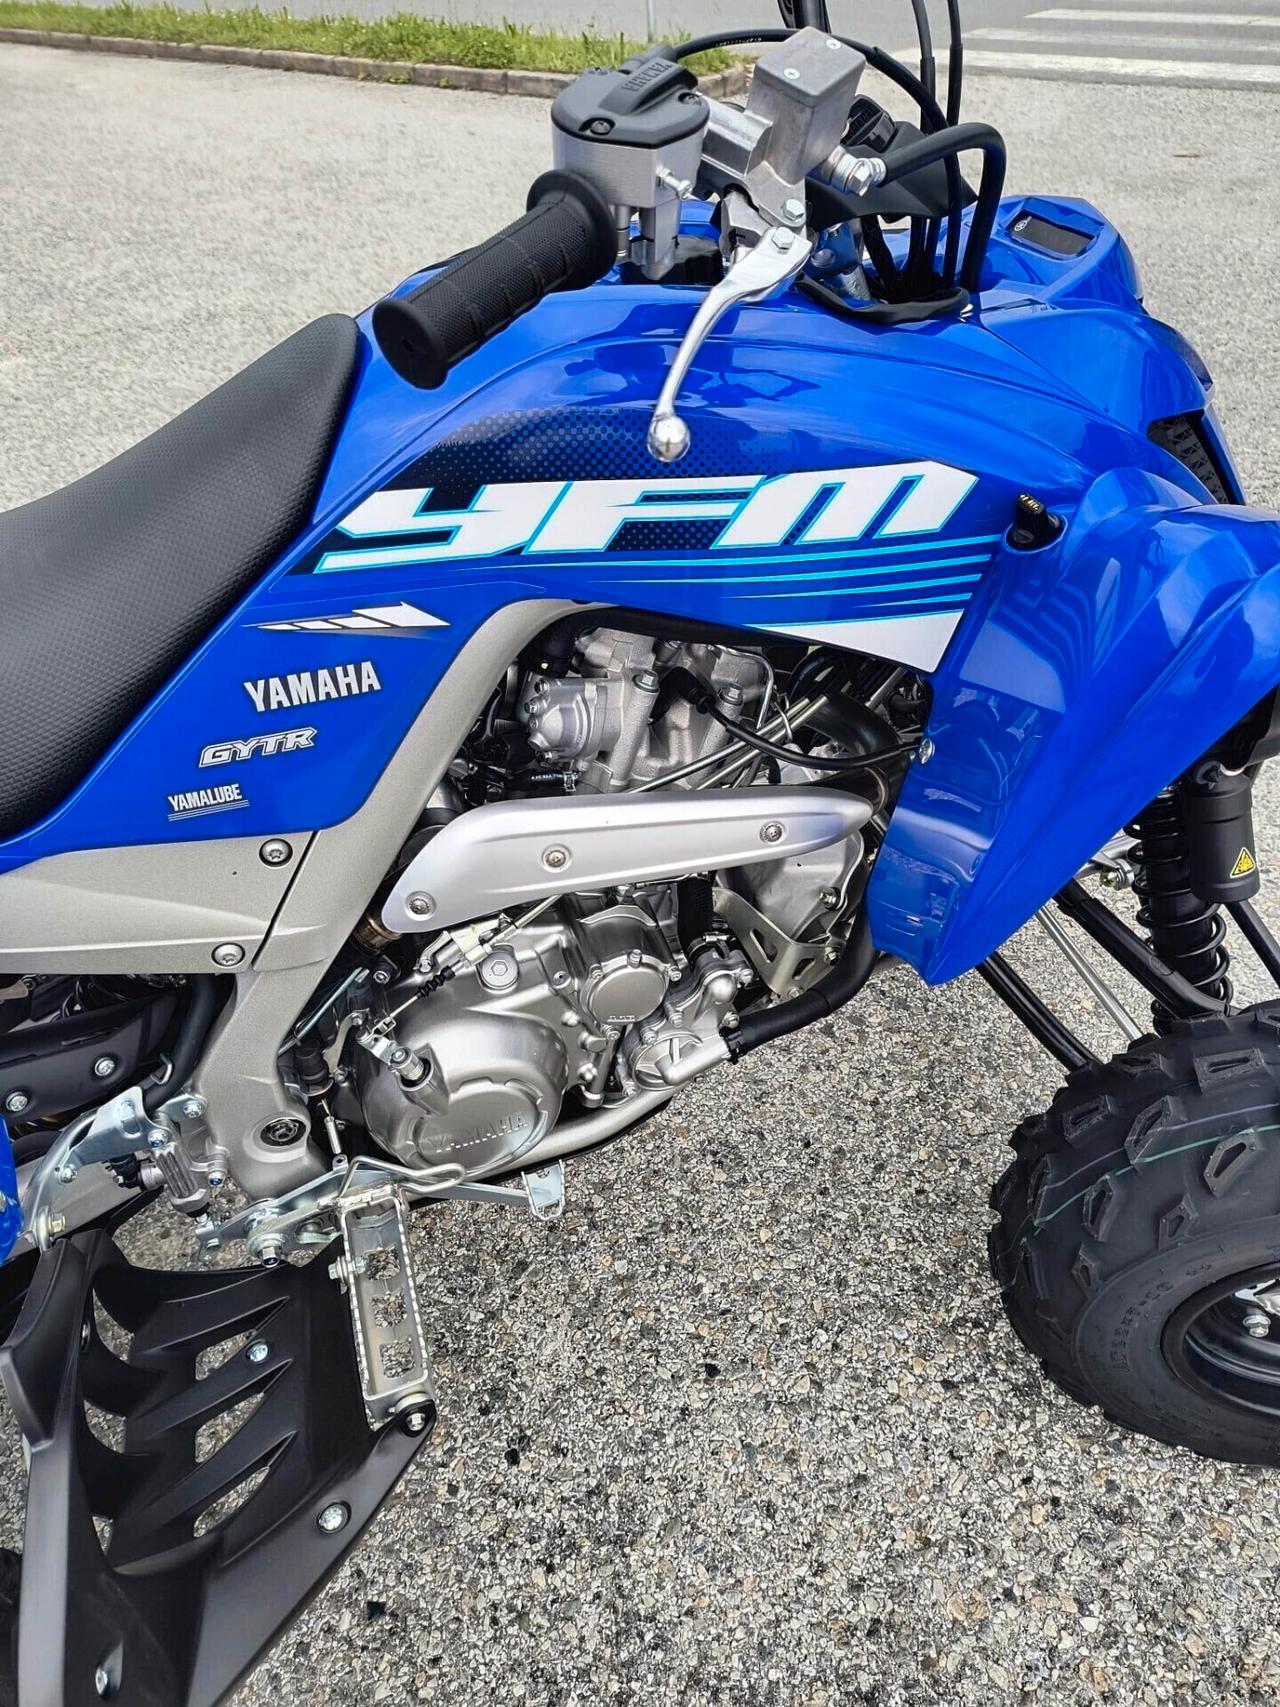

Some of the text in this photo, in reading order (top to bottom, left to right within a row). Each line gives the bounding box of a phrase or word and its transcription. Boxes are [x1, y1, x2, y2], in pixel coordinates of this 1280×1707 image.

[243, 660, 382, 713] YAMAHA
[198, 726, 318, 769] GYTR
[167, 783, 243, 812] YAMALUBE
